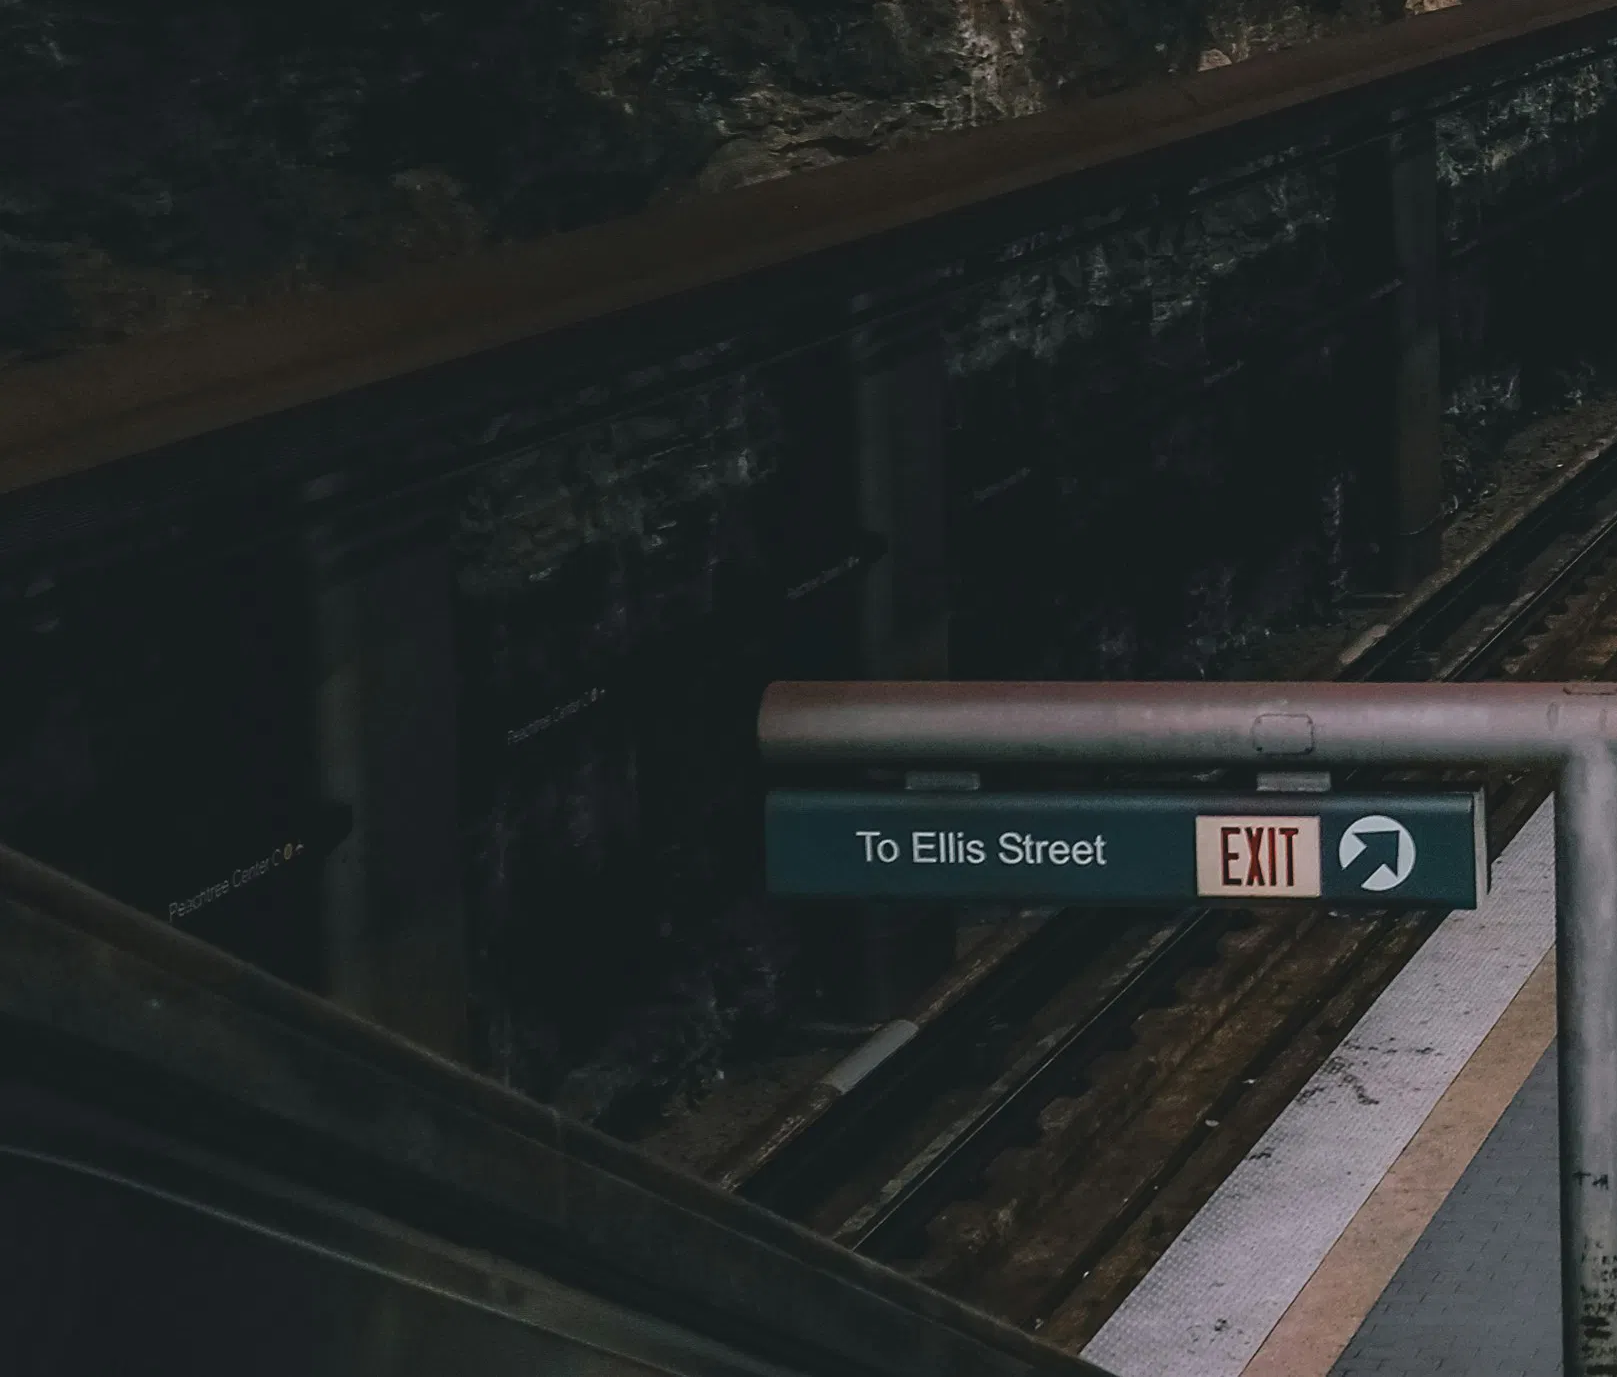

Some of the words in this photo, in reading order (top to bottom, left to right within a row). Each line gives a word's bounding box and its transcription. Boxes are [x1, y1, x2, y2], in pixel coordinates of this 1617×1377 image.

[856, 831, 898, 863] To
[912, 831, 985, 864] Ellis
[999, 832, 1106, 865] Street
[1221, 827, 1299, 886] EXIT
